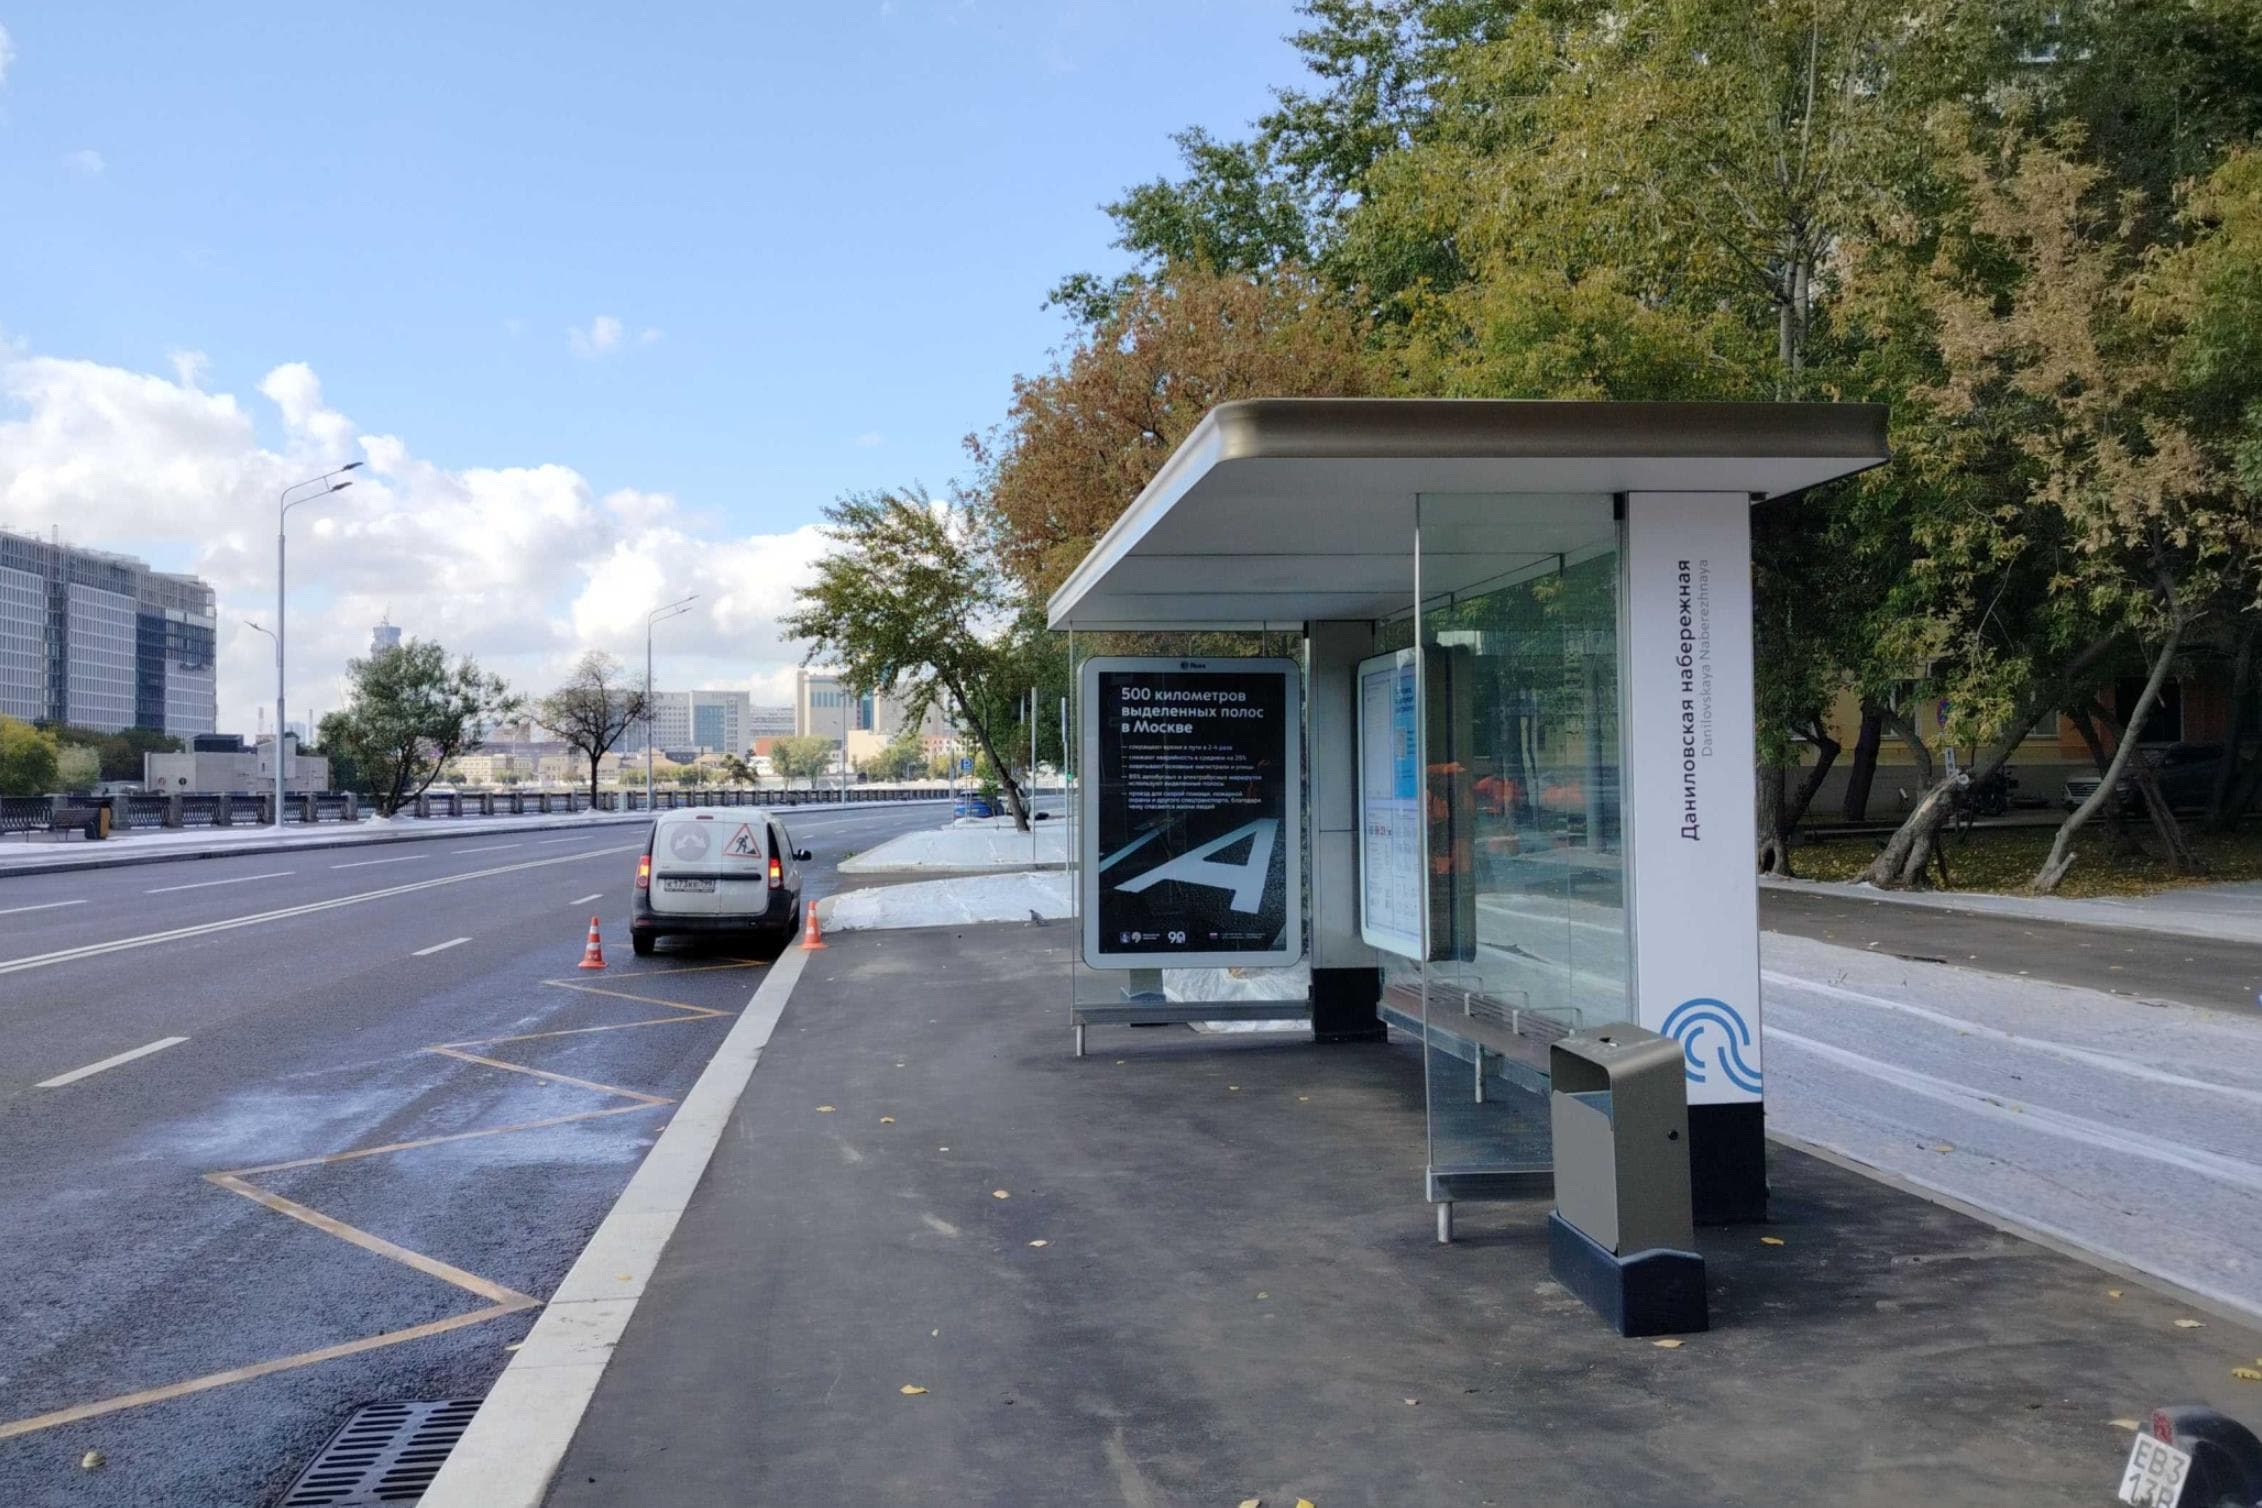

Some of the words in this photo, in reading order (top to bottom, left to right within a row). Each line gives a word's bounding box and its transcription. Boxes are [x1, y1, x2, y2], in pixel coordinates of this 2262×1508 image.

[1676, 559, 1696, 692] набережная
[1697, 559, 1712, 660] Naberezhnaya
[1121, 687, 1151, 700] 500
[1154, 690, 1247, 704] километров
[1121, 706, 1217, 718] выделенных
[1220, 707, 1265, 718] полос
[1121, 722, 1130, 733] в
[1132, 719, 1194, 733] Москве
[1701, 663, 1713, 757] Danilovskaya
[1681, 700, 1700, 841] Даниловская
